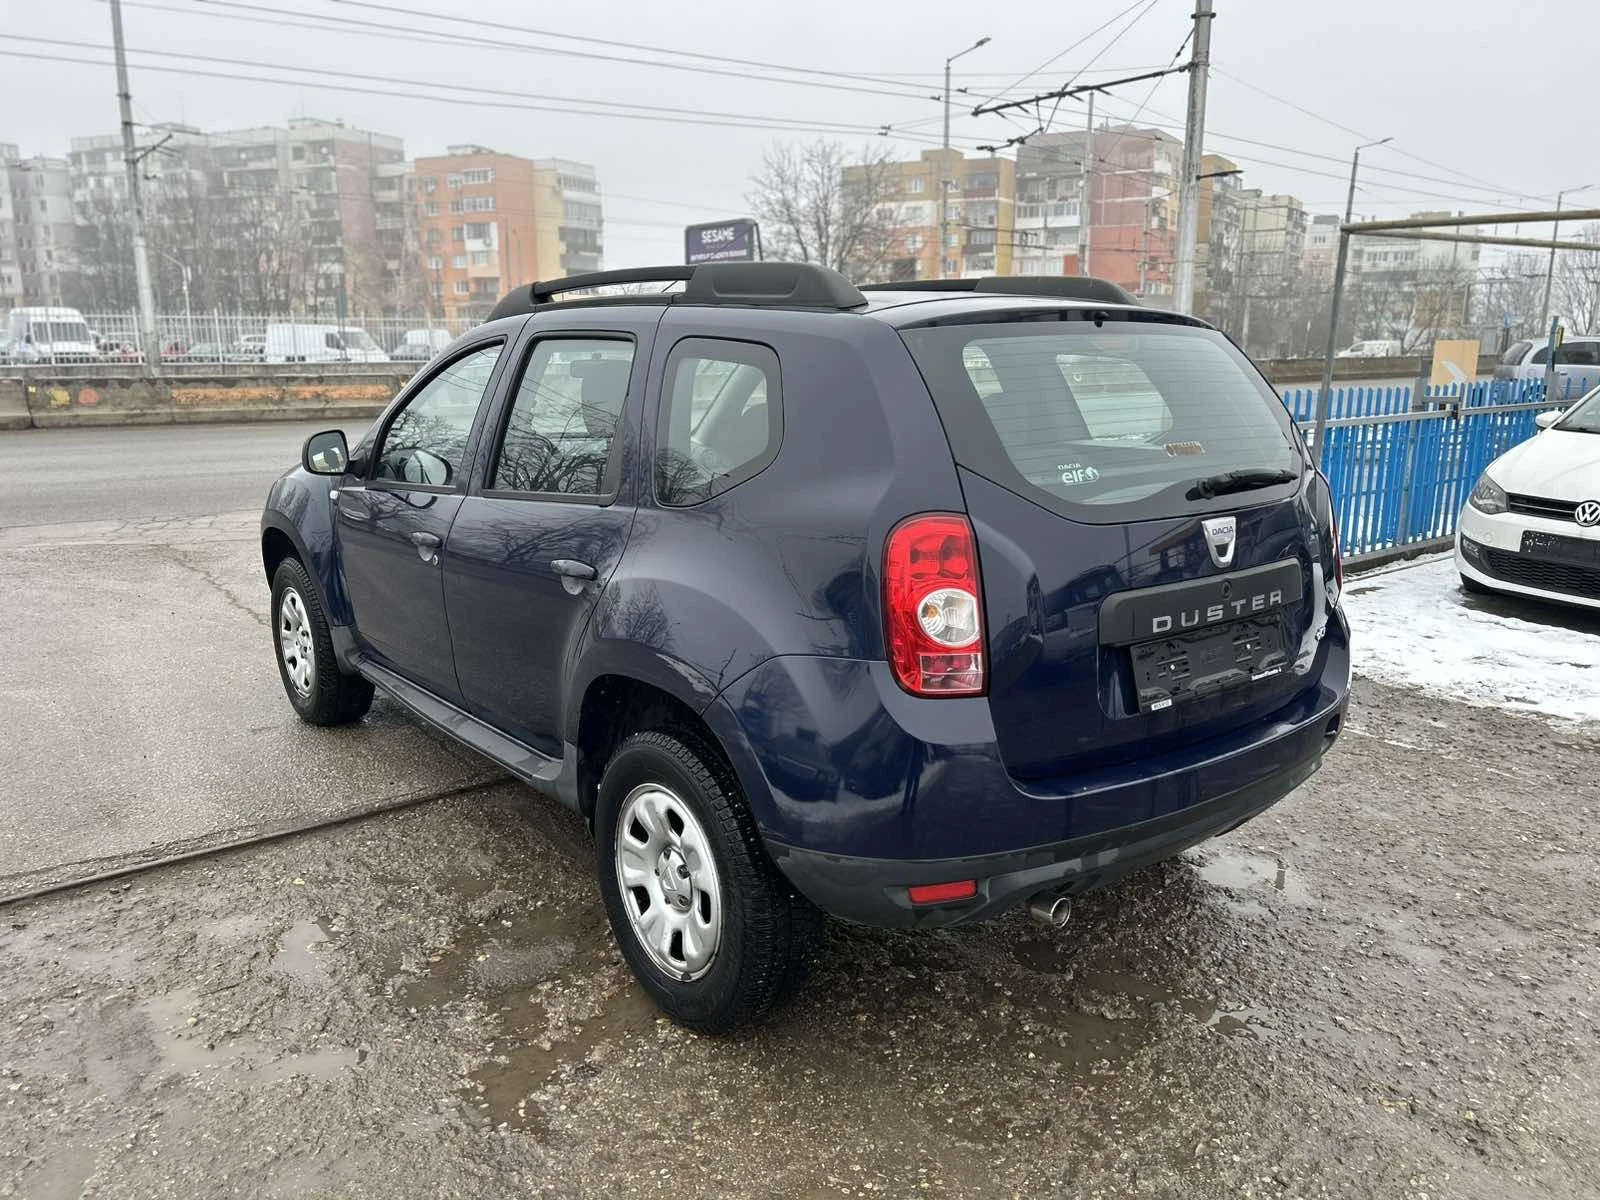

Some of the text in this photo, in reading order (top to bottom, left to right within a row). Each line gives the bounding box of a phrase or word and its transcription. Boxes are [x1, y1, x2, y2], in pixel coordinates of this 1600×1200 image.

[701, 227, 735, 244] SESAME
[1062, 469, 1085, 483] elf
[1212, 526, 1234, 536] DACIA
[1152, 590, 1283, 633] DUSTER
